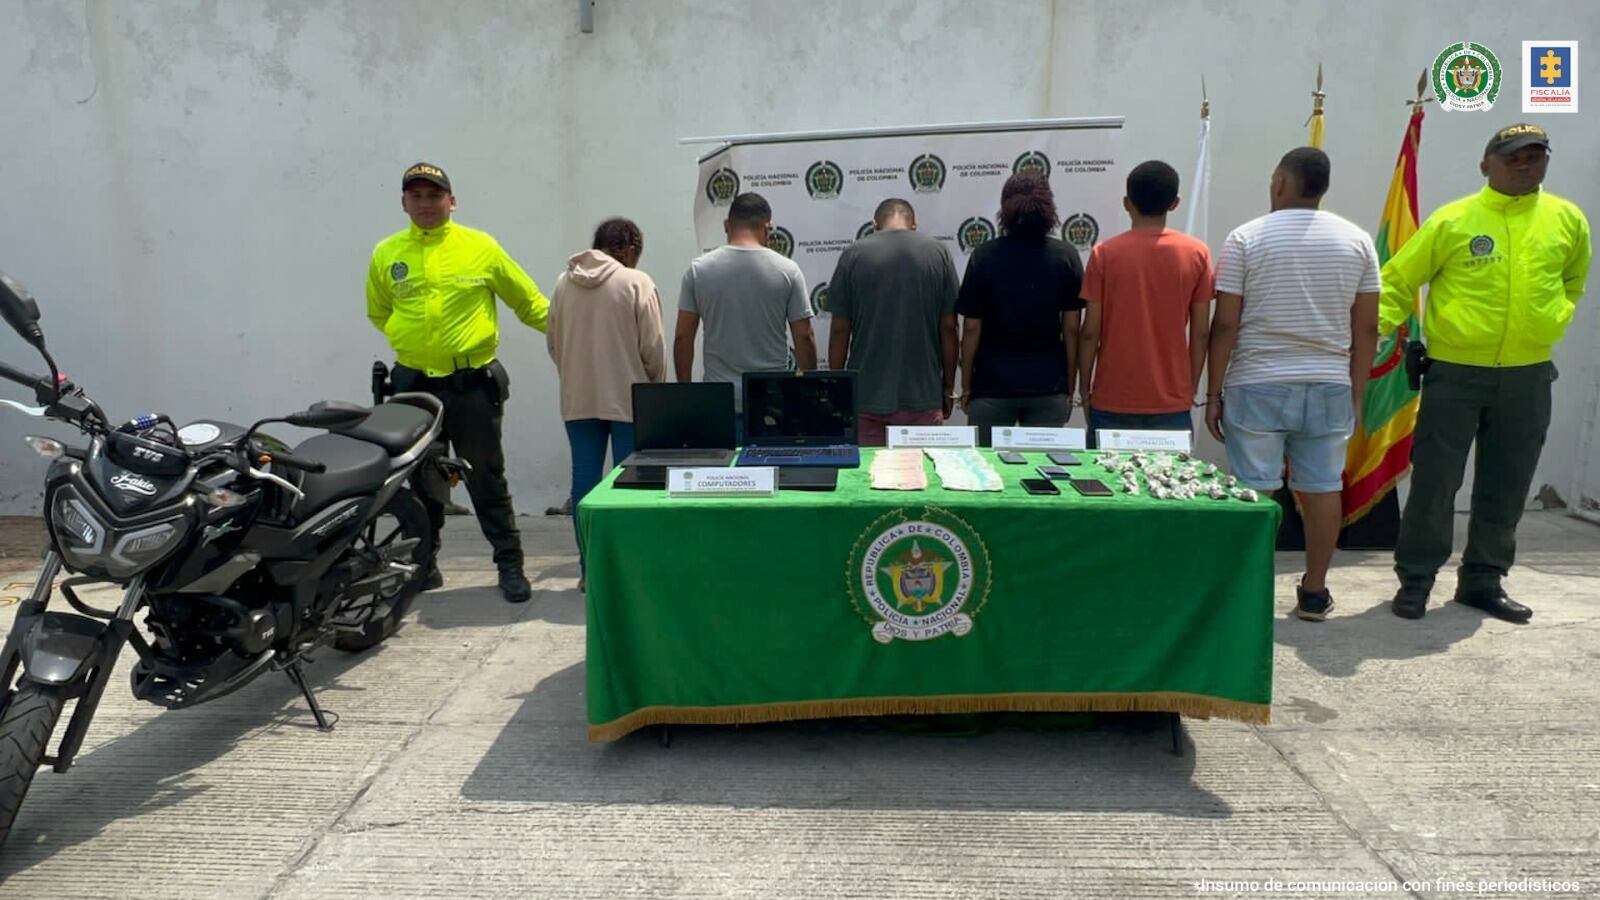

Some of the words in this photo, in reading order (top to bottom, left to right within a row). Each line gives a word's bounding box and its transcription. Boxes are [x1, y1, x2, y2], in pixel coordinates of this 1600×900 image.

[133, 446, 164, 462] TVS
[908, 524, 923, 533] DE
[934, 529, 970, 580] COLOMBIA
[922, 591, 967, 625] NACIONAL
[883, 622, 907, 637] DIOS
[913, 631, 920, 639] Y
[925, 616, 963, 637] PATRIA
